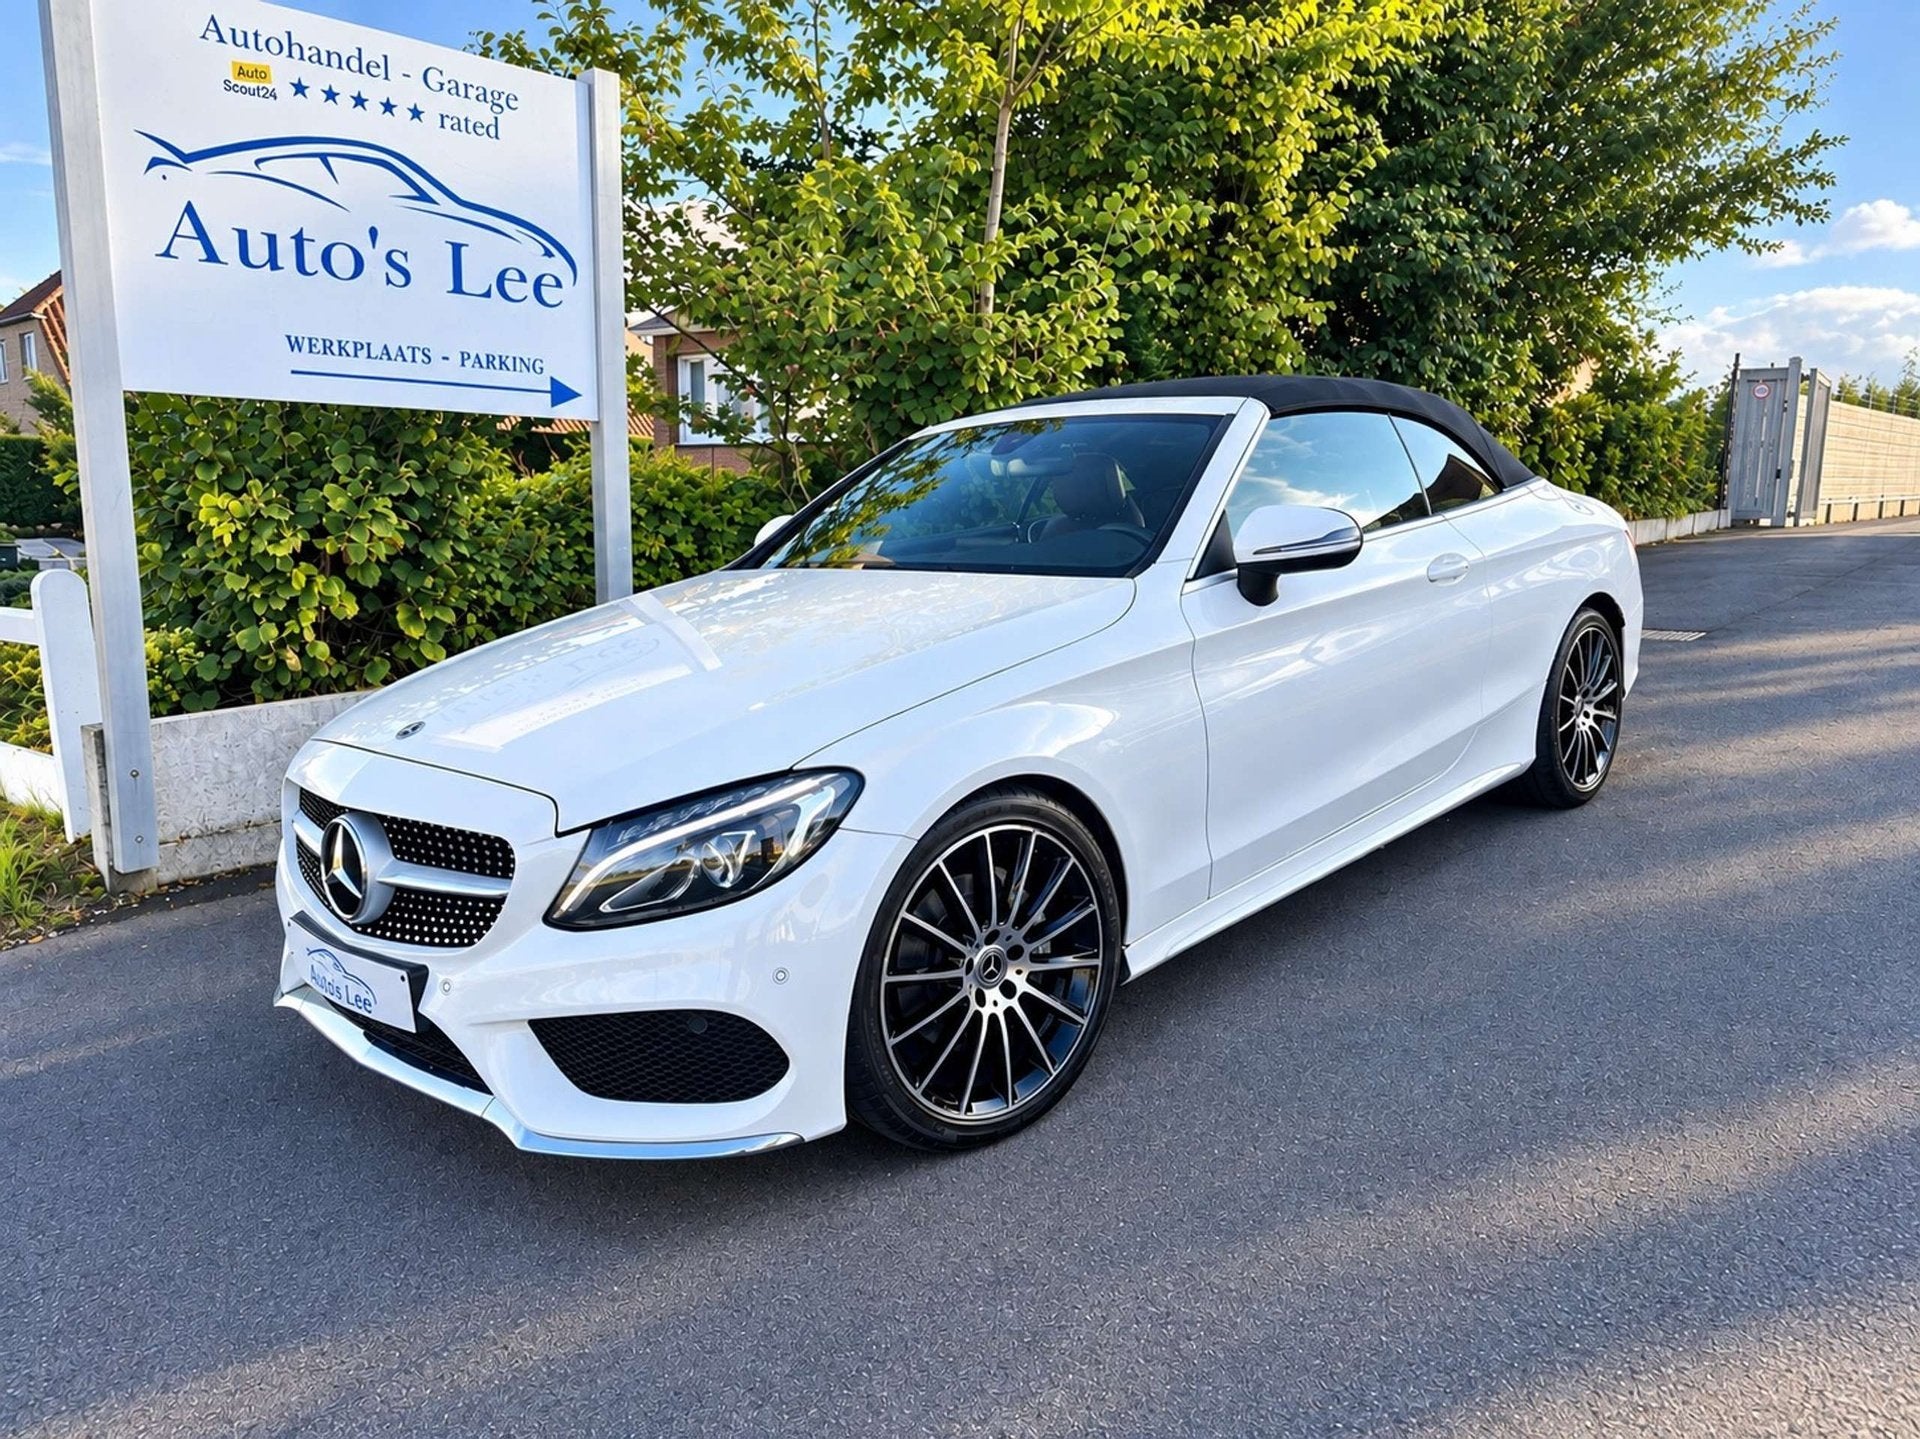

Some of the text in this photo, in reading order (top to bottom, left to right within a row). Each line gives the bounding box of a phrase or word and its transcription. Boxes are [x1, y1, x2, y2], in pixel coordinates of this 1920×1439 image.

[199, 14, 390, 82] Autohandel
[422, 66, 519, 115] Garage
[237, 65, 268, 80] Auto
[223, 78, 278, 101] Scout24
[438, 112, 501, 140] rated
[154, 200, 564, 309] Auto's Lee
[284, 334, 432, 365] WERKPLAATS
[459, 351, 544, 375] PARKING
[345, 984, 372, 1014] Lee
